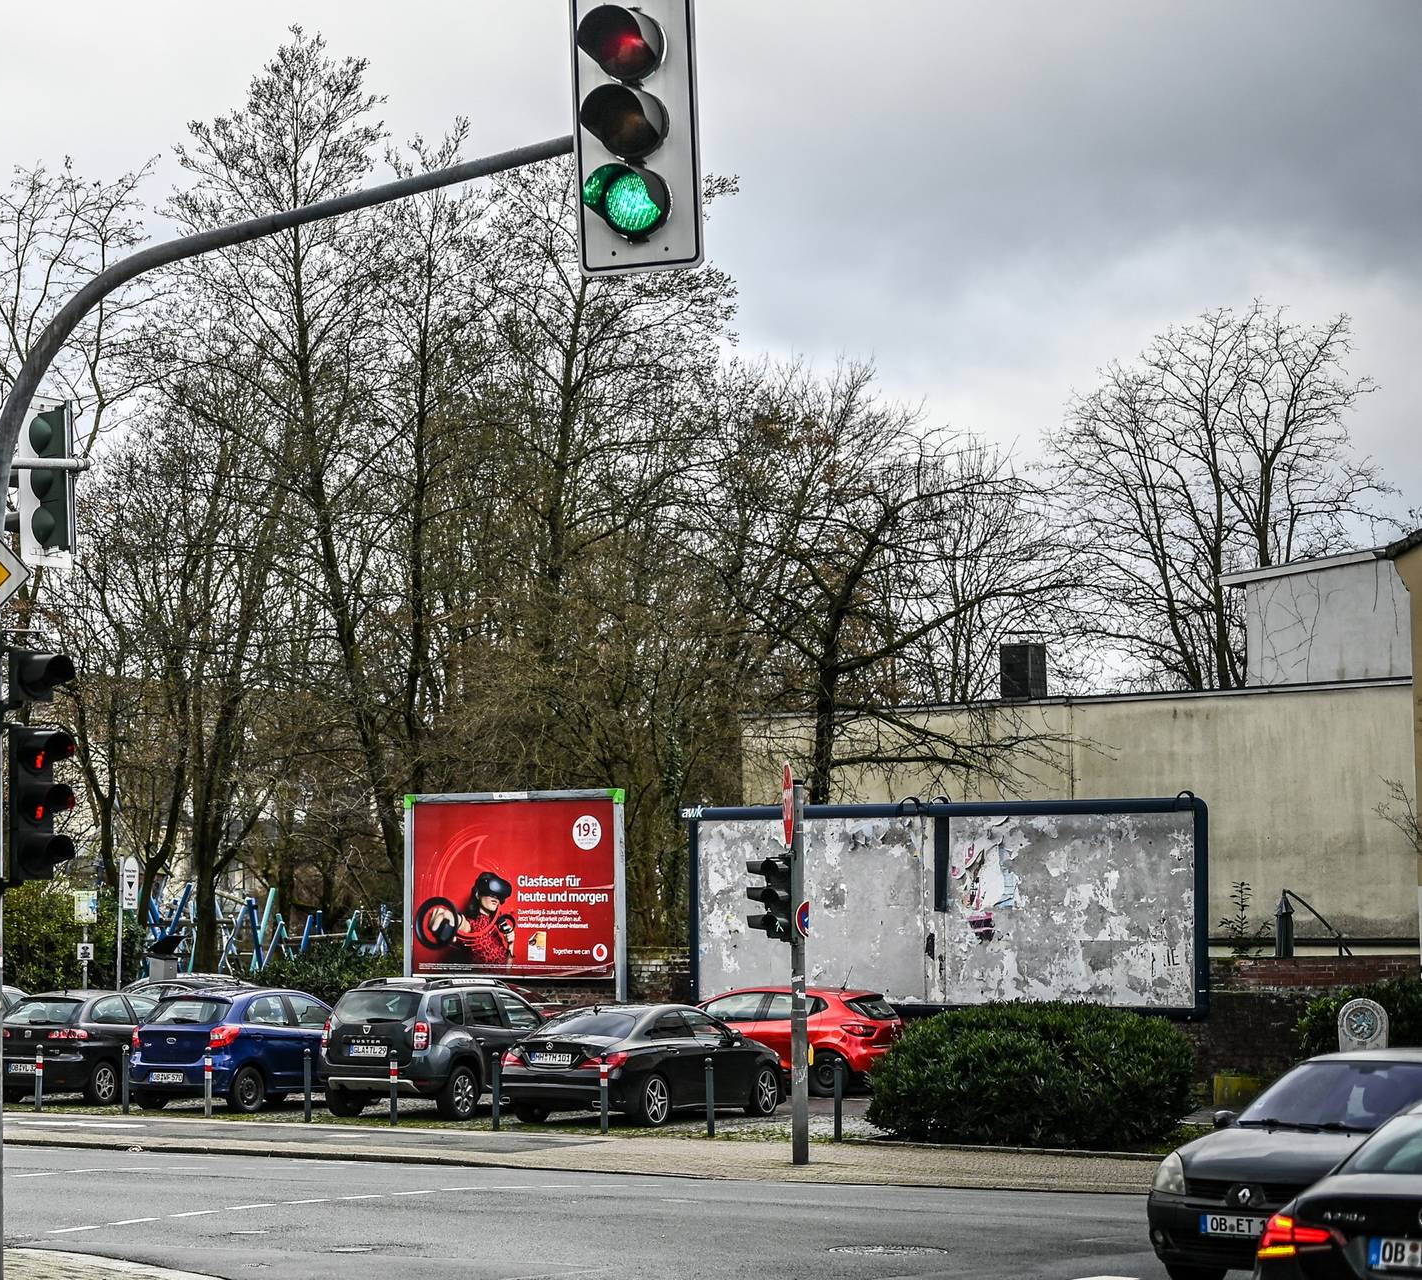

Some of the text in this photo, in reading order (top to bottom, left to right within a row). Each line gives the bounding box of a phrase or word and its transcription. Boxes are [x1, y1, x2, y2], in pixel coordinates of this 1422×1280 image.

[681, 804, 704, 818] awk
[576, 823, 591, 837] 19
[517, 874, 582, 887] Glasfaser für
[517, 891, 609, 906] heute und morgen
[552, 948, 574, 956] Together
[378, 1047, 386, 1055] 29
[557, 1054, 570, 1062] 101
[1210, 1216, 1228, 1232] OB
[1236, 1218, 1254, 1233] ET
[1381, 1241, 1406, 1264] OB
